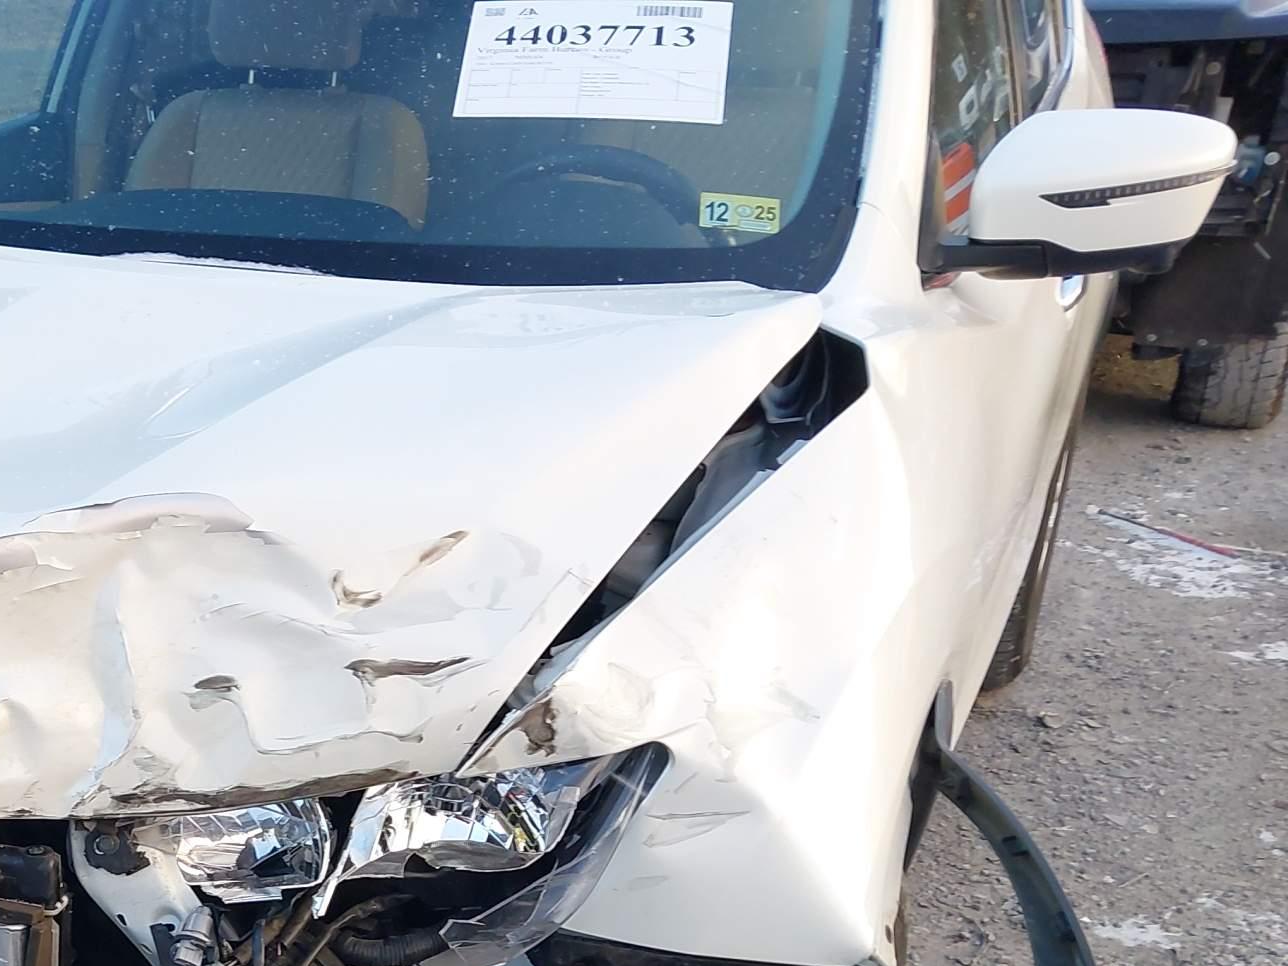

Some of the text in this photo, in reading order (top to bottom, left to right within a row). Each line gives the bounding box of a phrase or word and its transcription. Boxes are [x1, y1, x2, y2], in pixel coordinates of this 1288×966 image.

[494, 24, 696, 47] 44037713
[704, 201, 729, 222] 12
[754, 205, 777, 221] 25
